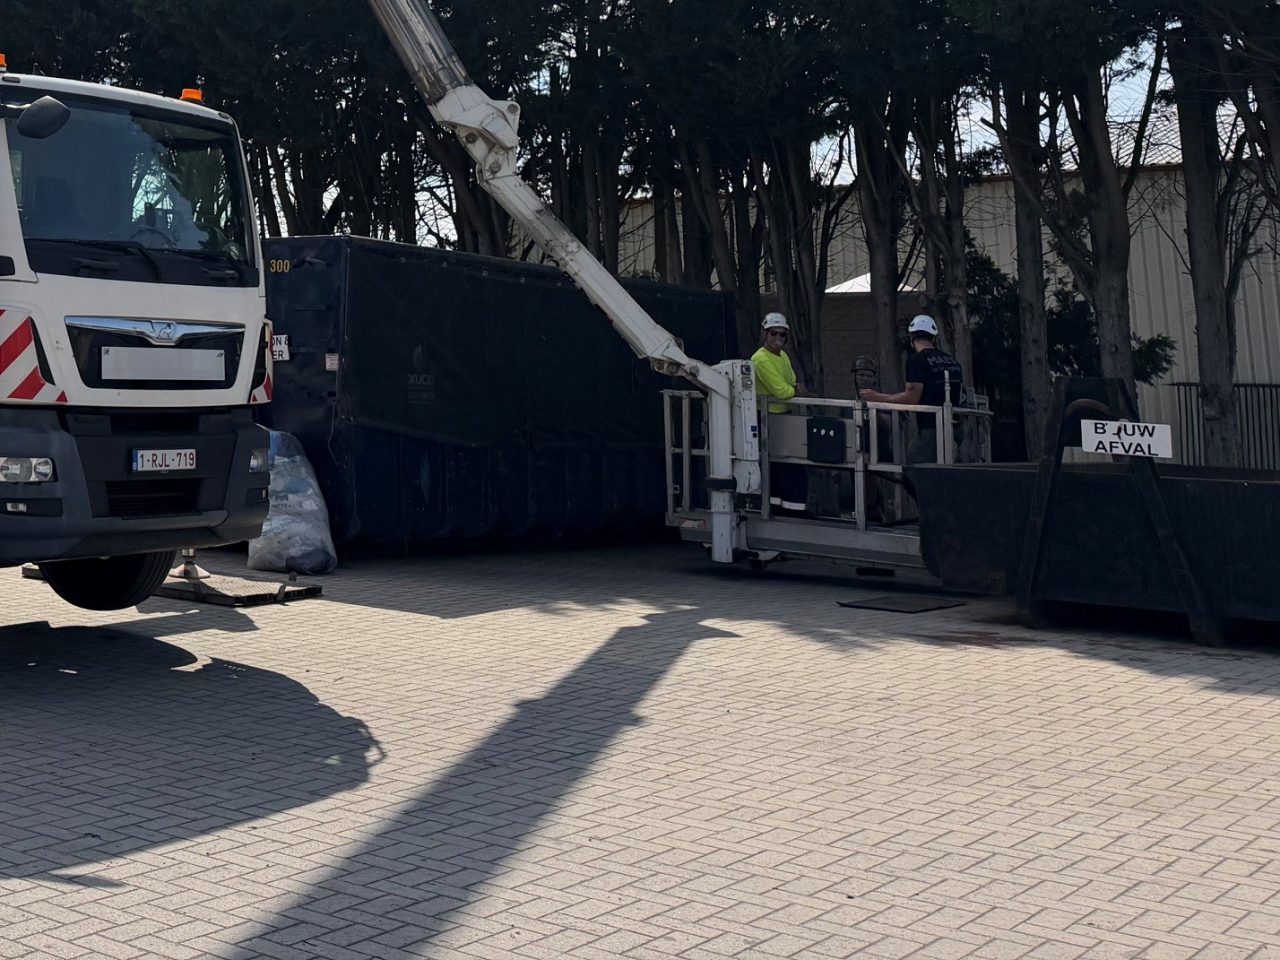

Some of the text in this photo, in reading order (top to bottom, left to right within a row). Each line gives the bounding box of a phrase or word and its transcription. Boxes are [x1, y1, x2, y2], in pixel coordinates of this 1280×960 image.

[270, 259, 290, 273] 300
[1094, 422, 1156, 438] BUW
[1094, 440, 1160, 457] AFVAL
